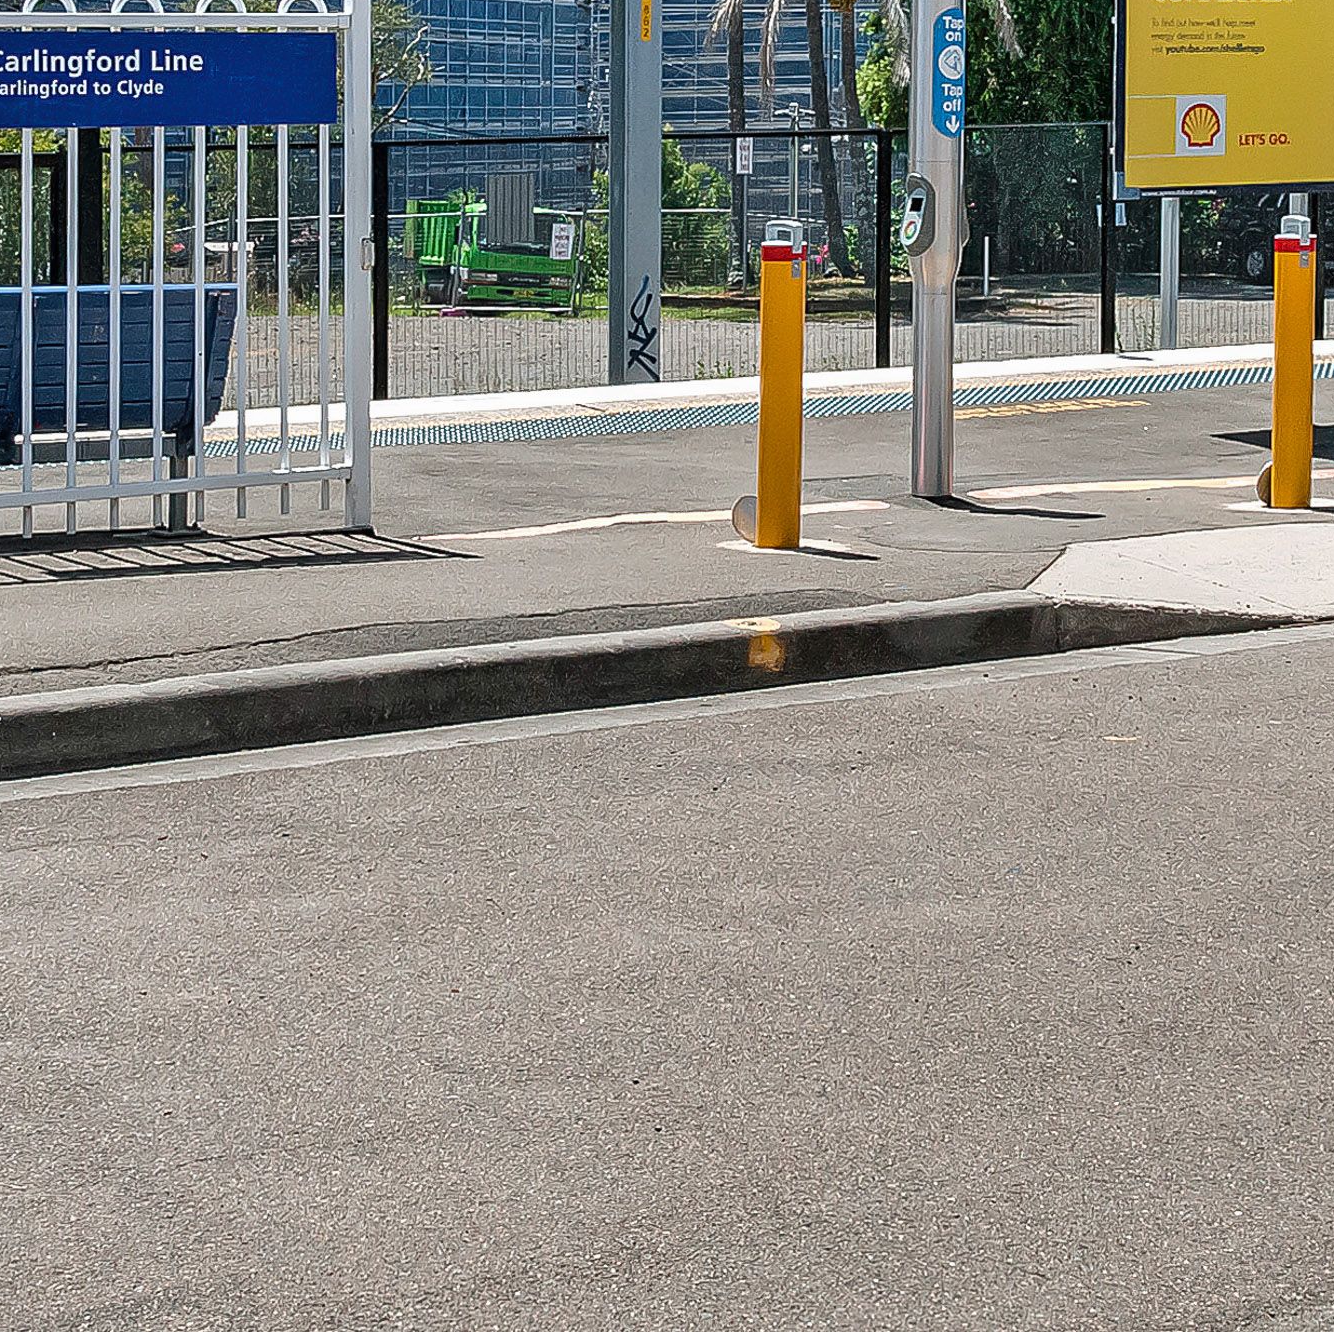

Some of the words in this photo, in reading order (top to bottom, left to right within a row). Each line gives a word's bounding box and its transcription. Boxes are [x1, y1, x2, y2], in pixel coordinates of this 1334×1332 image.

[942, 15, 964, 31] Tap
[945, 30, 962, 42] on
[151, 49, 204, 72] Line
[93, 82, 112, 95] to
[117, 79, 164, 98] Clyde
[941, 83, 963, 98] Tap
[942, 98, 962, 112] off
[1238, 133, 1266, 146] LET'S
[1268, 133, 1291, 146] GO.
